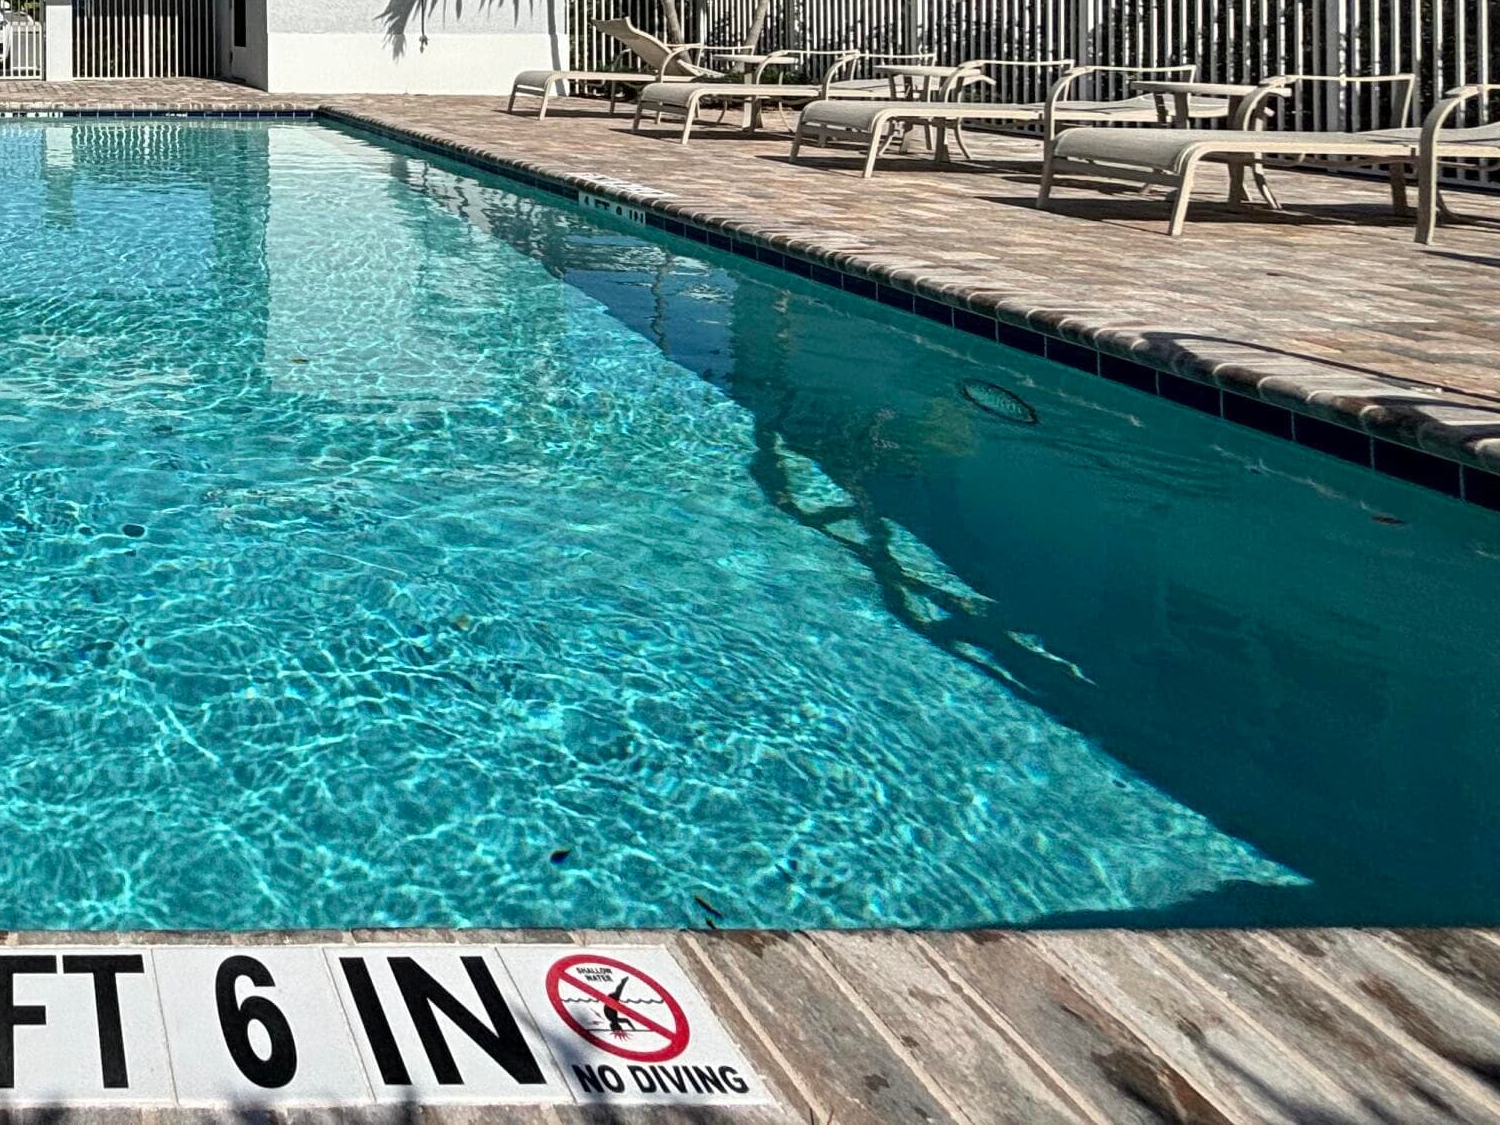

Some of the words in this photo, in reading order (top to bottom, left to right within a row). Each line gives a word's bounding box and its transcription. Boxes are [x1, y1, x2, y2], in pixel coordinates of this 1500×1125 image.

[595, 198, 610, 211] FT
[628, 209, 644, 224] IN
[576, 967, 612, 975] SHALLOW
[584, 974, 614, 982] WATER
[215, 955, 297, 1089] 6
[338, 956, 548, 1085] IN
[572, 1064, 625, 1093] NO
[627, 1064, 750, 1094] DIVING
